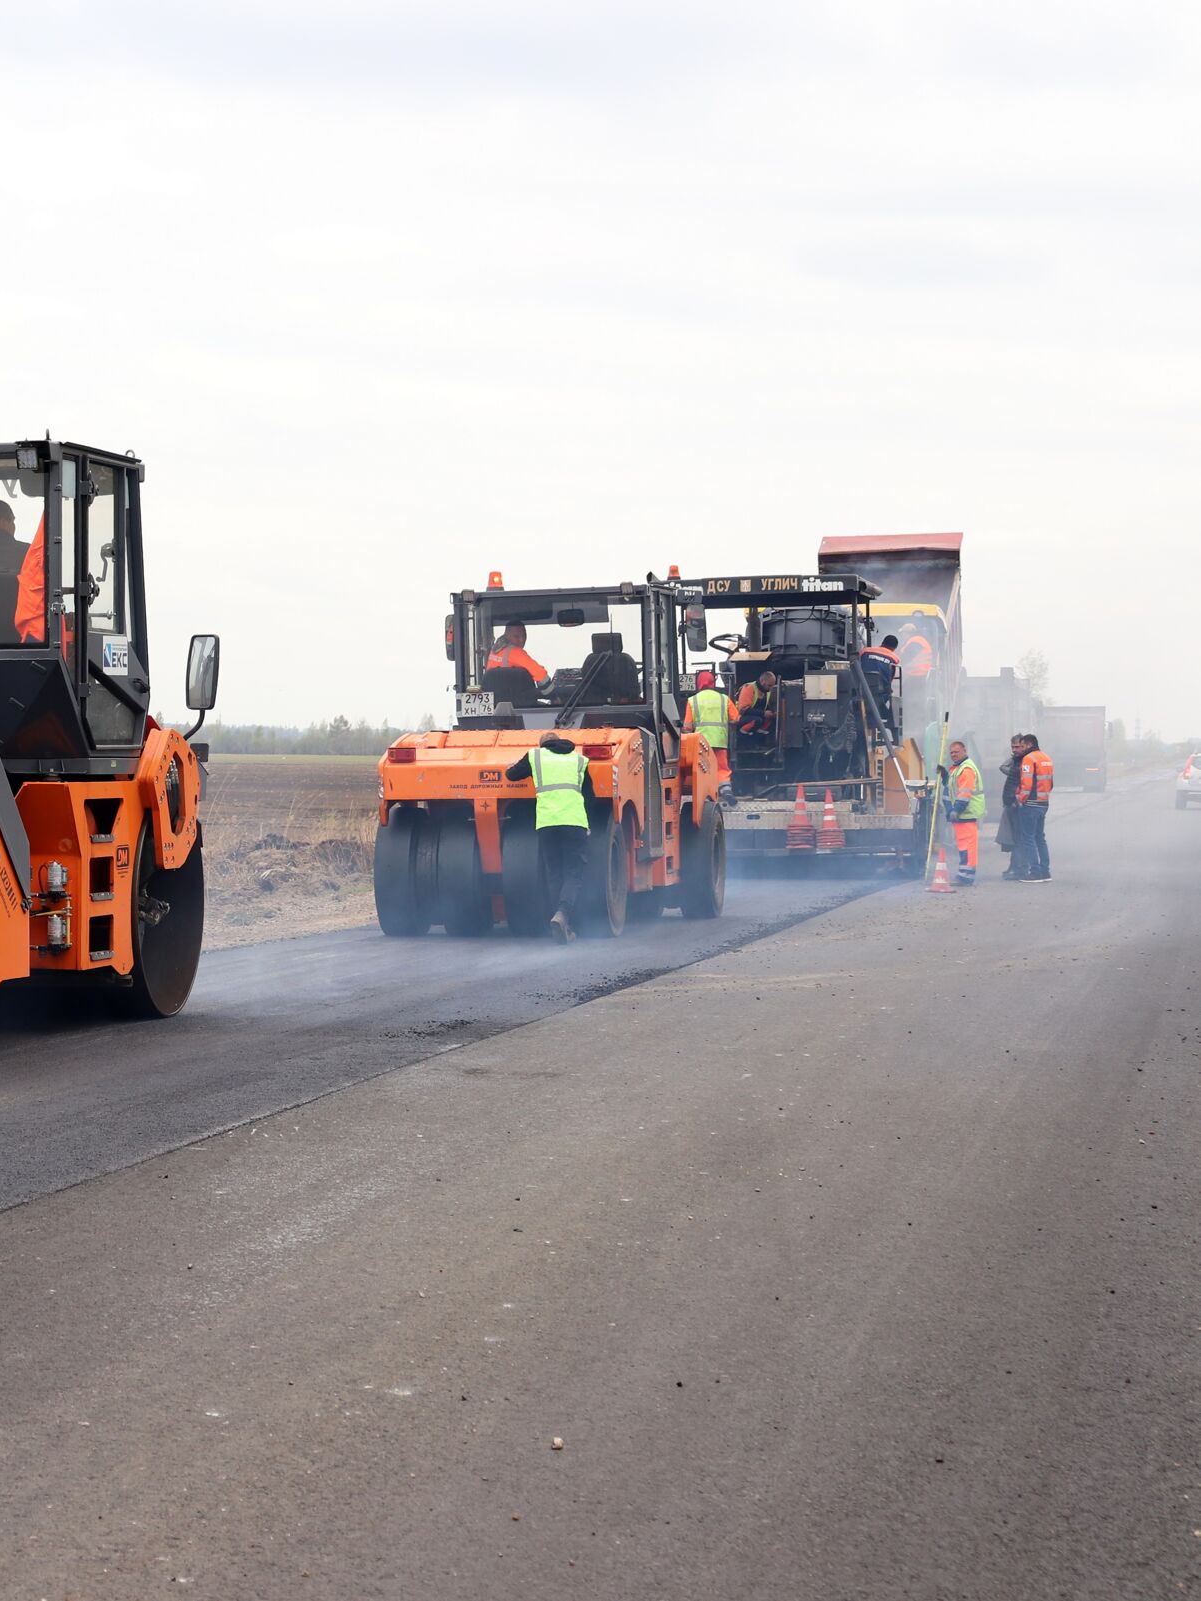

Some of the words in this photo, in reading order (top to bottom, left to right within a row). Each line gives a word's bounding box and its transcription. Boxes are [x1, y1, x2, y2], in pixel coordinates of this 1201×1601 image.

[707, 580, 731, 594] ДСУ
[761, 577, 798, 592] УГЛИЧ
[802, 577, 845, 592] titan
[465, 694, 489, 704] 2793
[482, 704, 492, 712] 76
